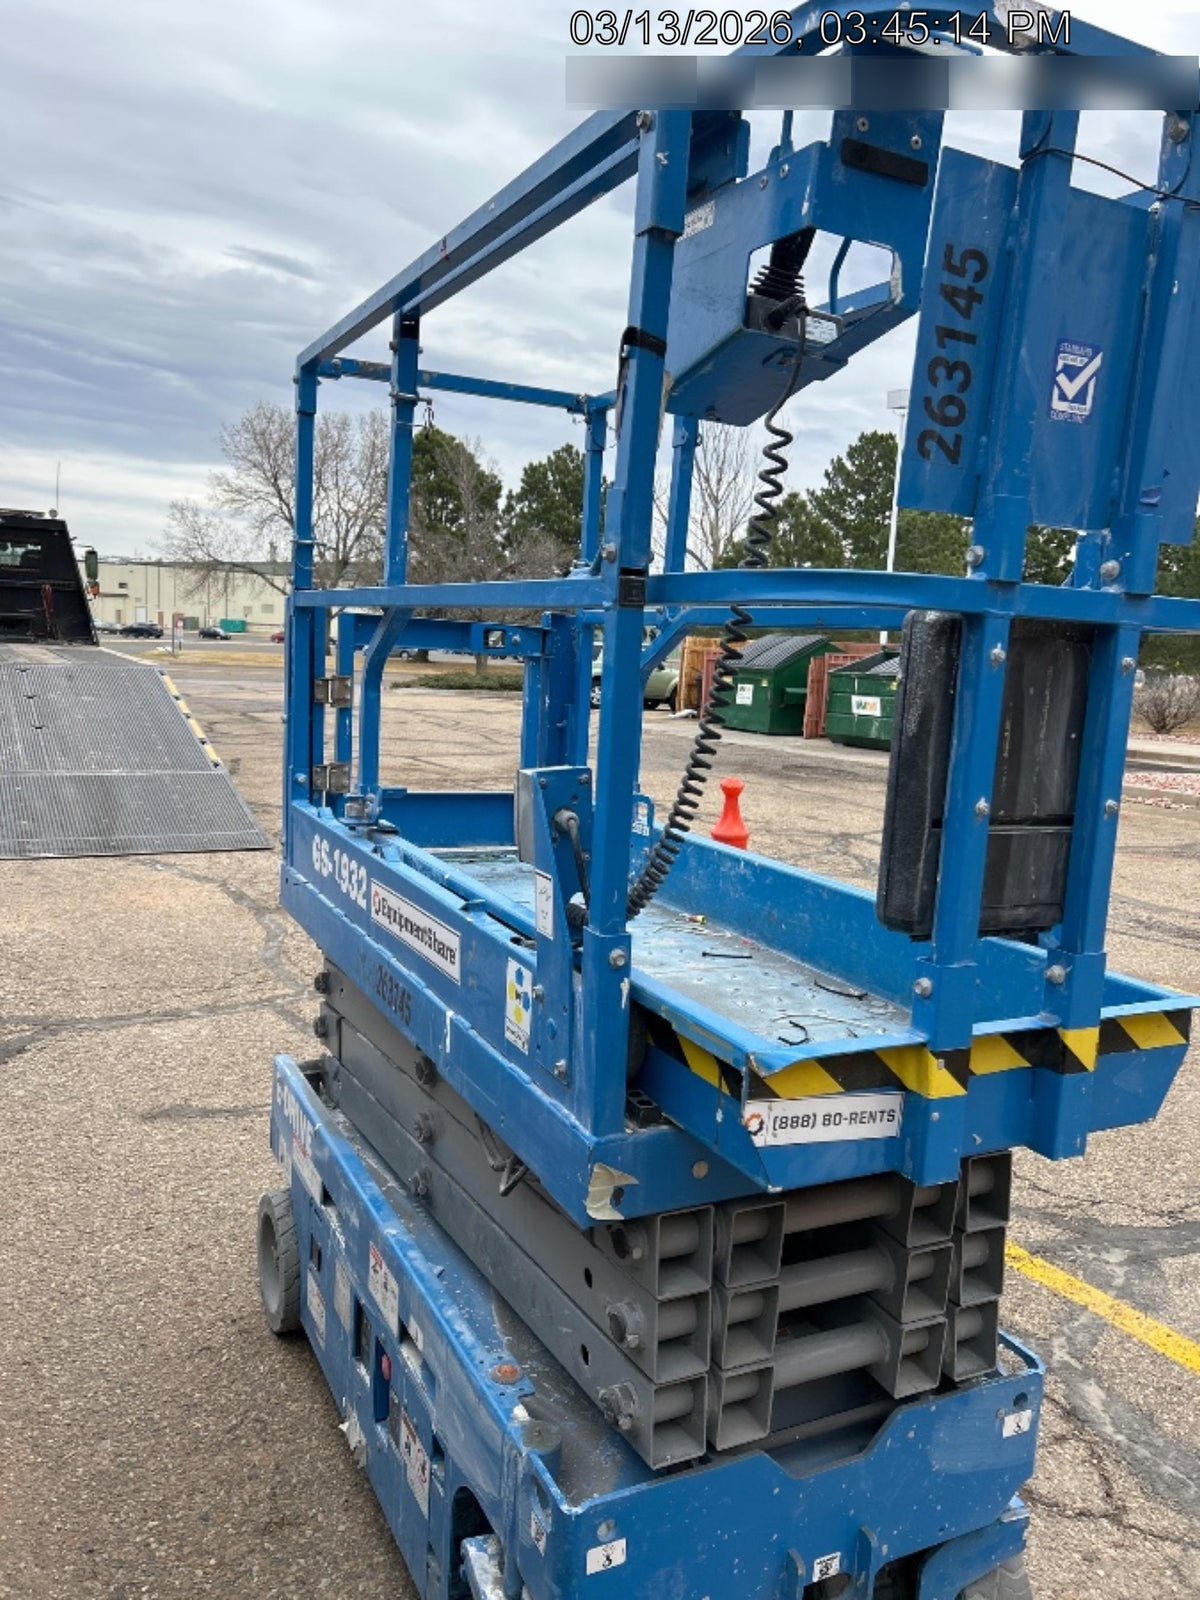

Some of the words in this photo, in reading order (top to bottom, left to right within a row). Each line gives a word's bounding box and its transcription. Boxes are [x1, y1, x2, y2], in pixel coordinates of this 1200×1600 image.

[917, 244, 989, 465] 263145
[312, 834, 367, 911] GS-1932
[381, 896, 457, 966] EquipmentShare
[773, 1112, 817, 1131] (888)
